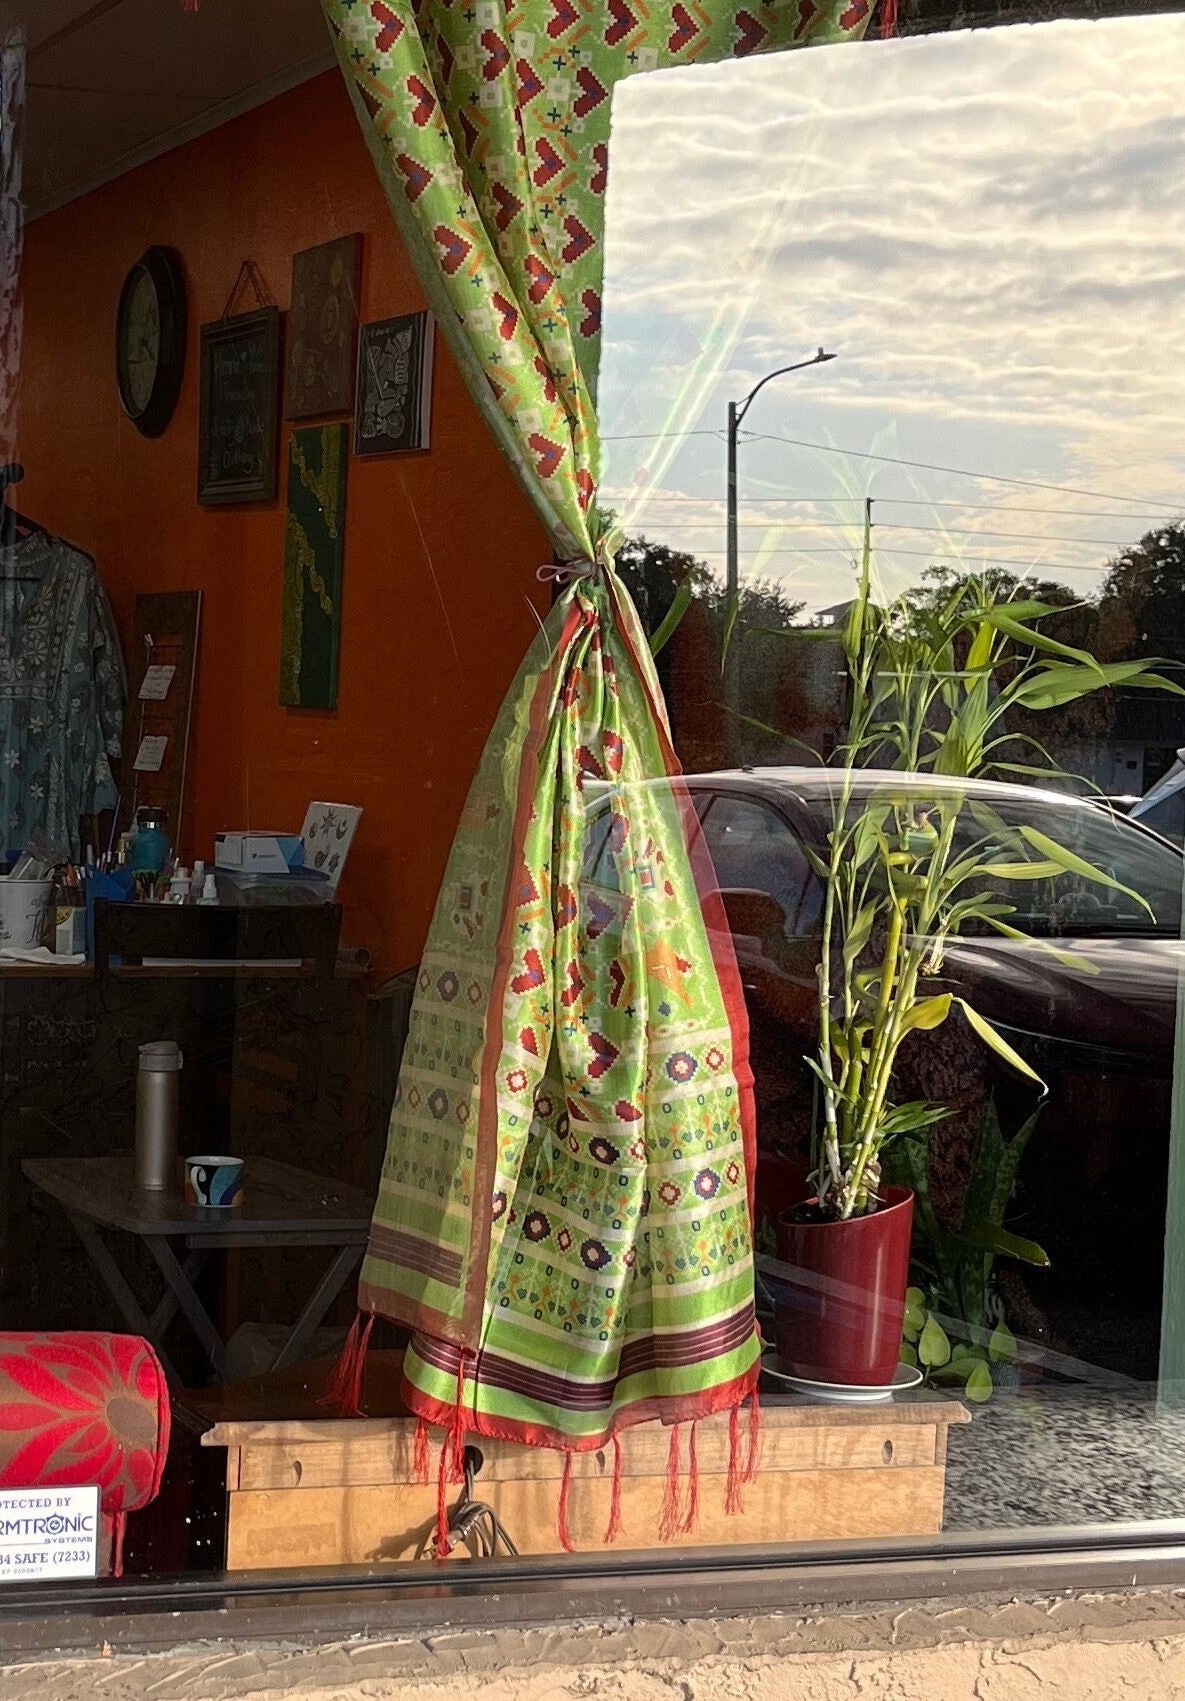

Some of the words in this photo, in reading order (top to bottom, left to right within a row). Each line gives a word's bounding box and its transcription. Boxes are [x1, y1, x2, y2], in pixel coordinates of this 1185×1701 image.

[55, 1497, 72, 1508] BY
[44, 1536, 93, 1545] SYSTEMS
[14, 1552, 49, 1564] SAFE
[52, 1550, 91, 1564] (7233)
